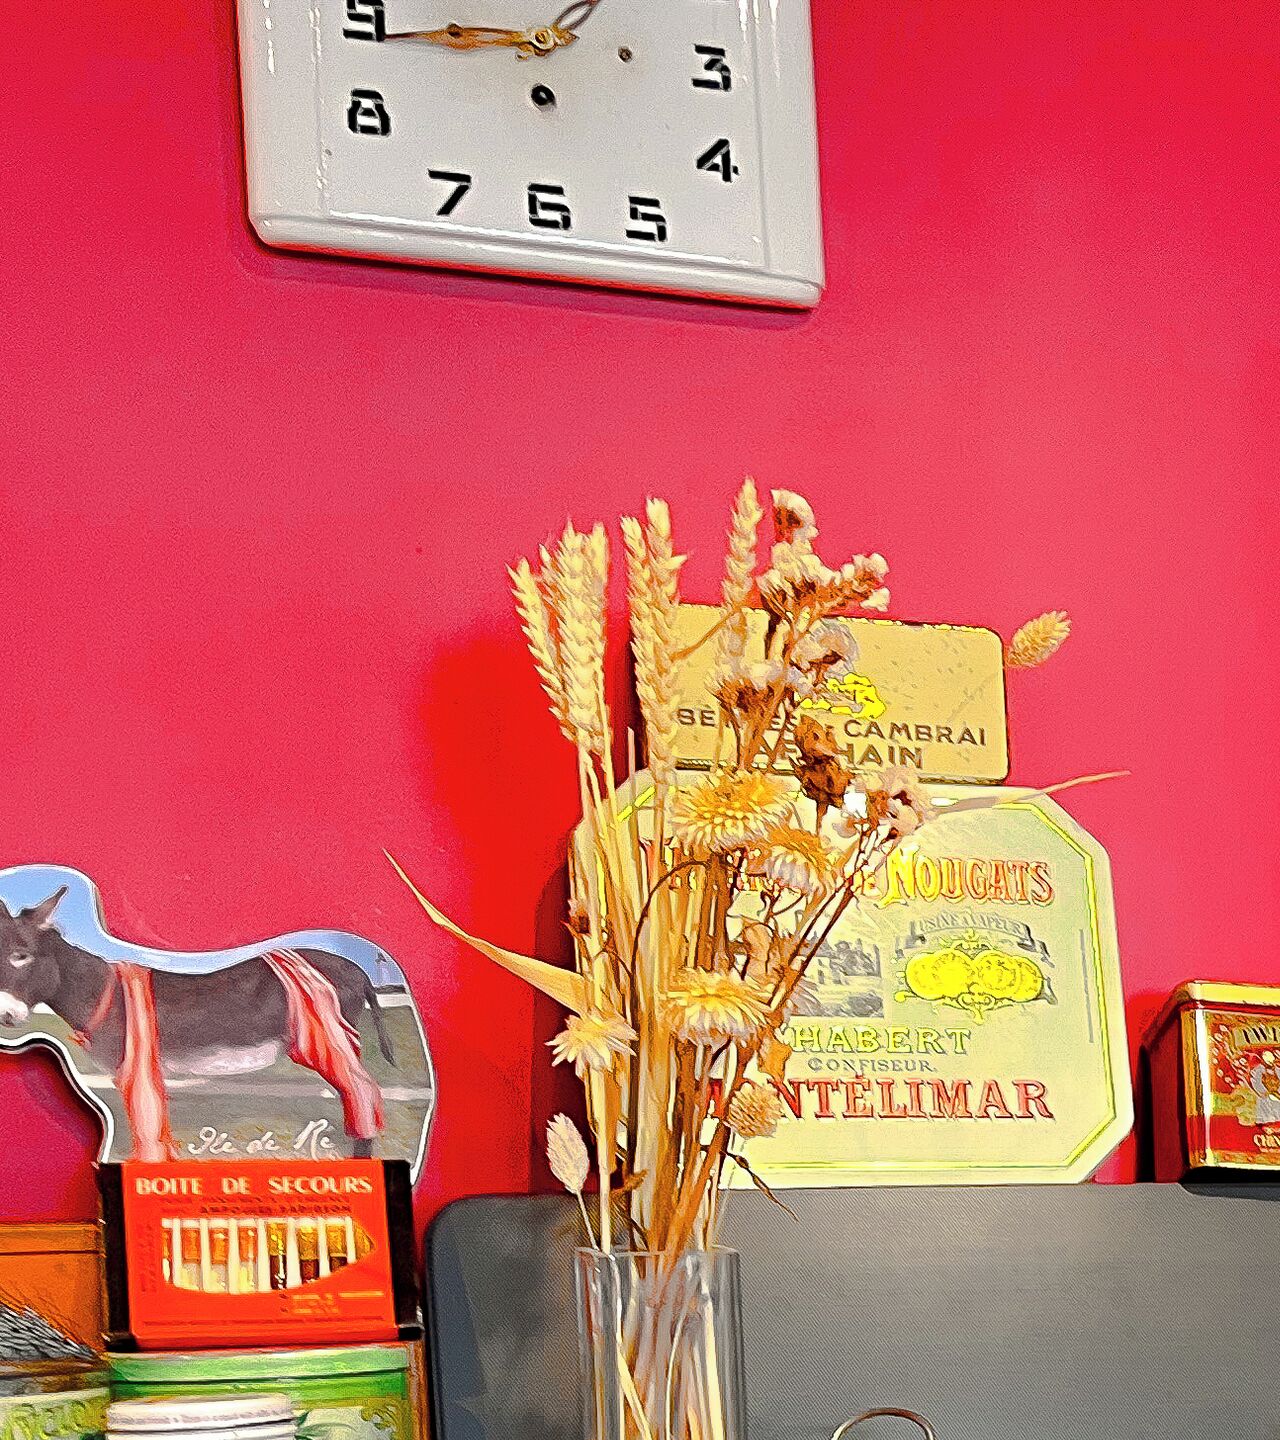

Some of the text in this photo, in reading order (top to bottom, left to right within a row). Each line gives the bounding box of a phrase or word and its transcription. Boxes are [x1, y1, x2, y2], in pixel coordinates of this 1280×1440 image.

[692, 45, 731, 91] 3
[347, 88, 390, 135] 8
[696, 138, 739, 182] 4
[427, 169, 471, 215] 7
[528, 183, 571, 230] 6
[626, 195, 668, 242] 5
[843, 718, 987, 747] CAMBRAI
[874, 844, 1056, 908] NOUGATS
[780, 1025, 972, 1056] HABERT
[710, 1073, 1056, 1121] NTÉLIMAR
[134, 1175, 374, 1196] BOITE DE SECOURS
